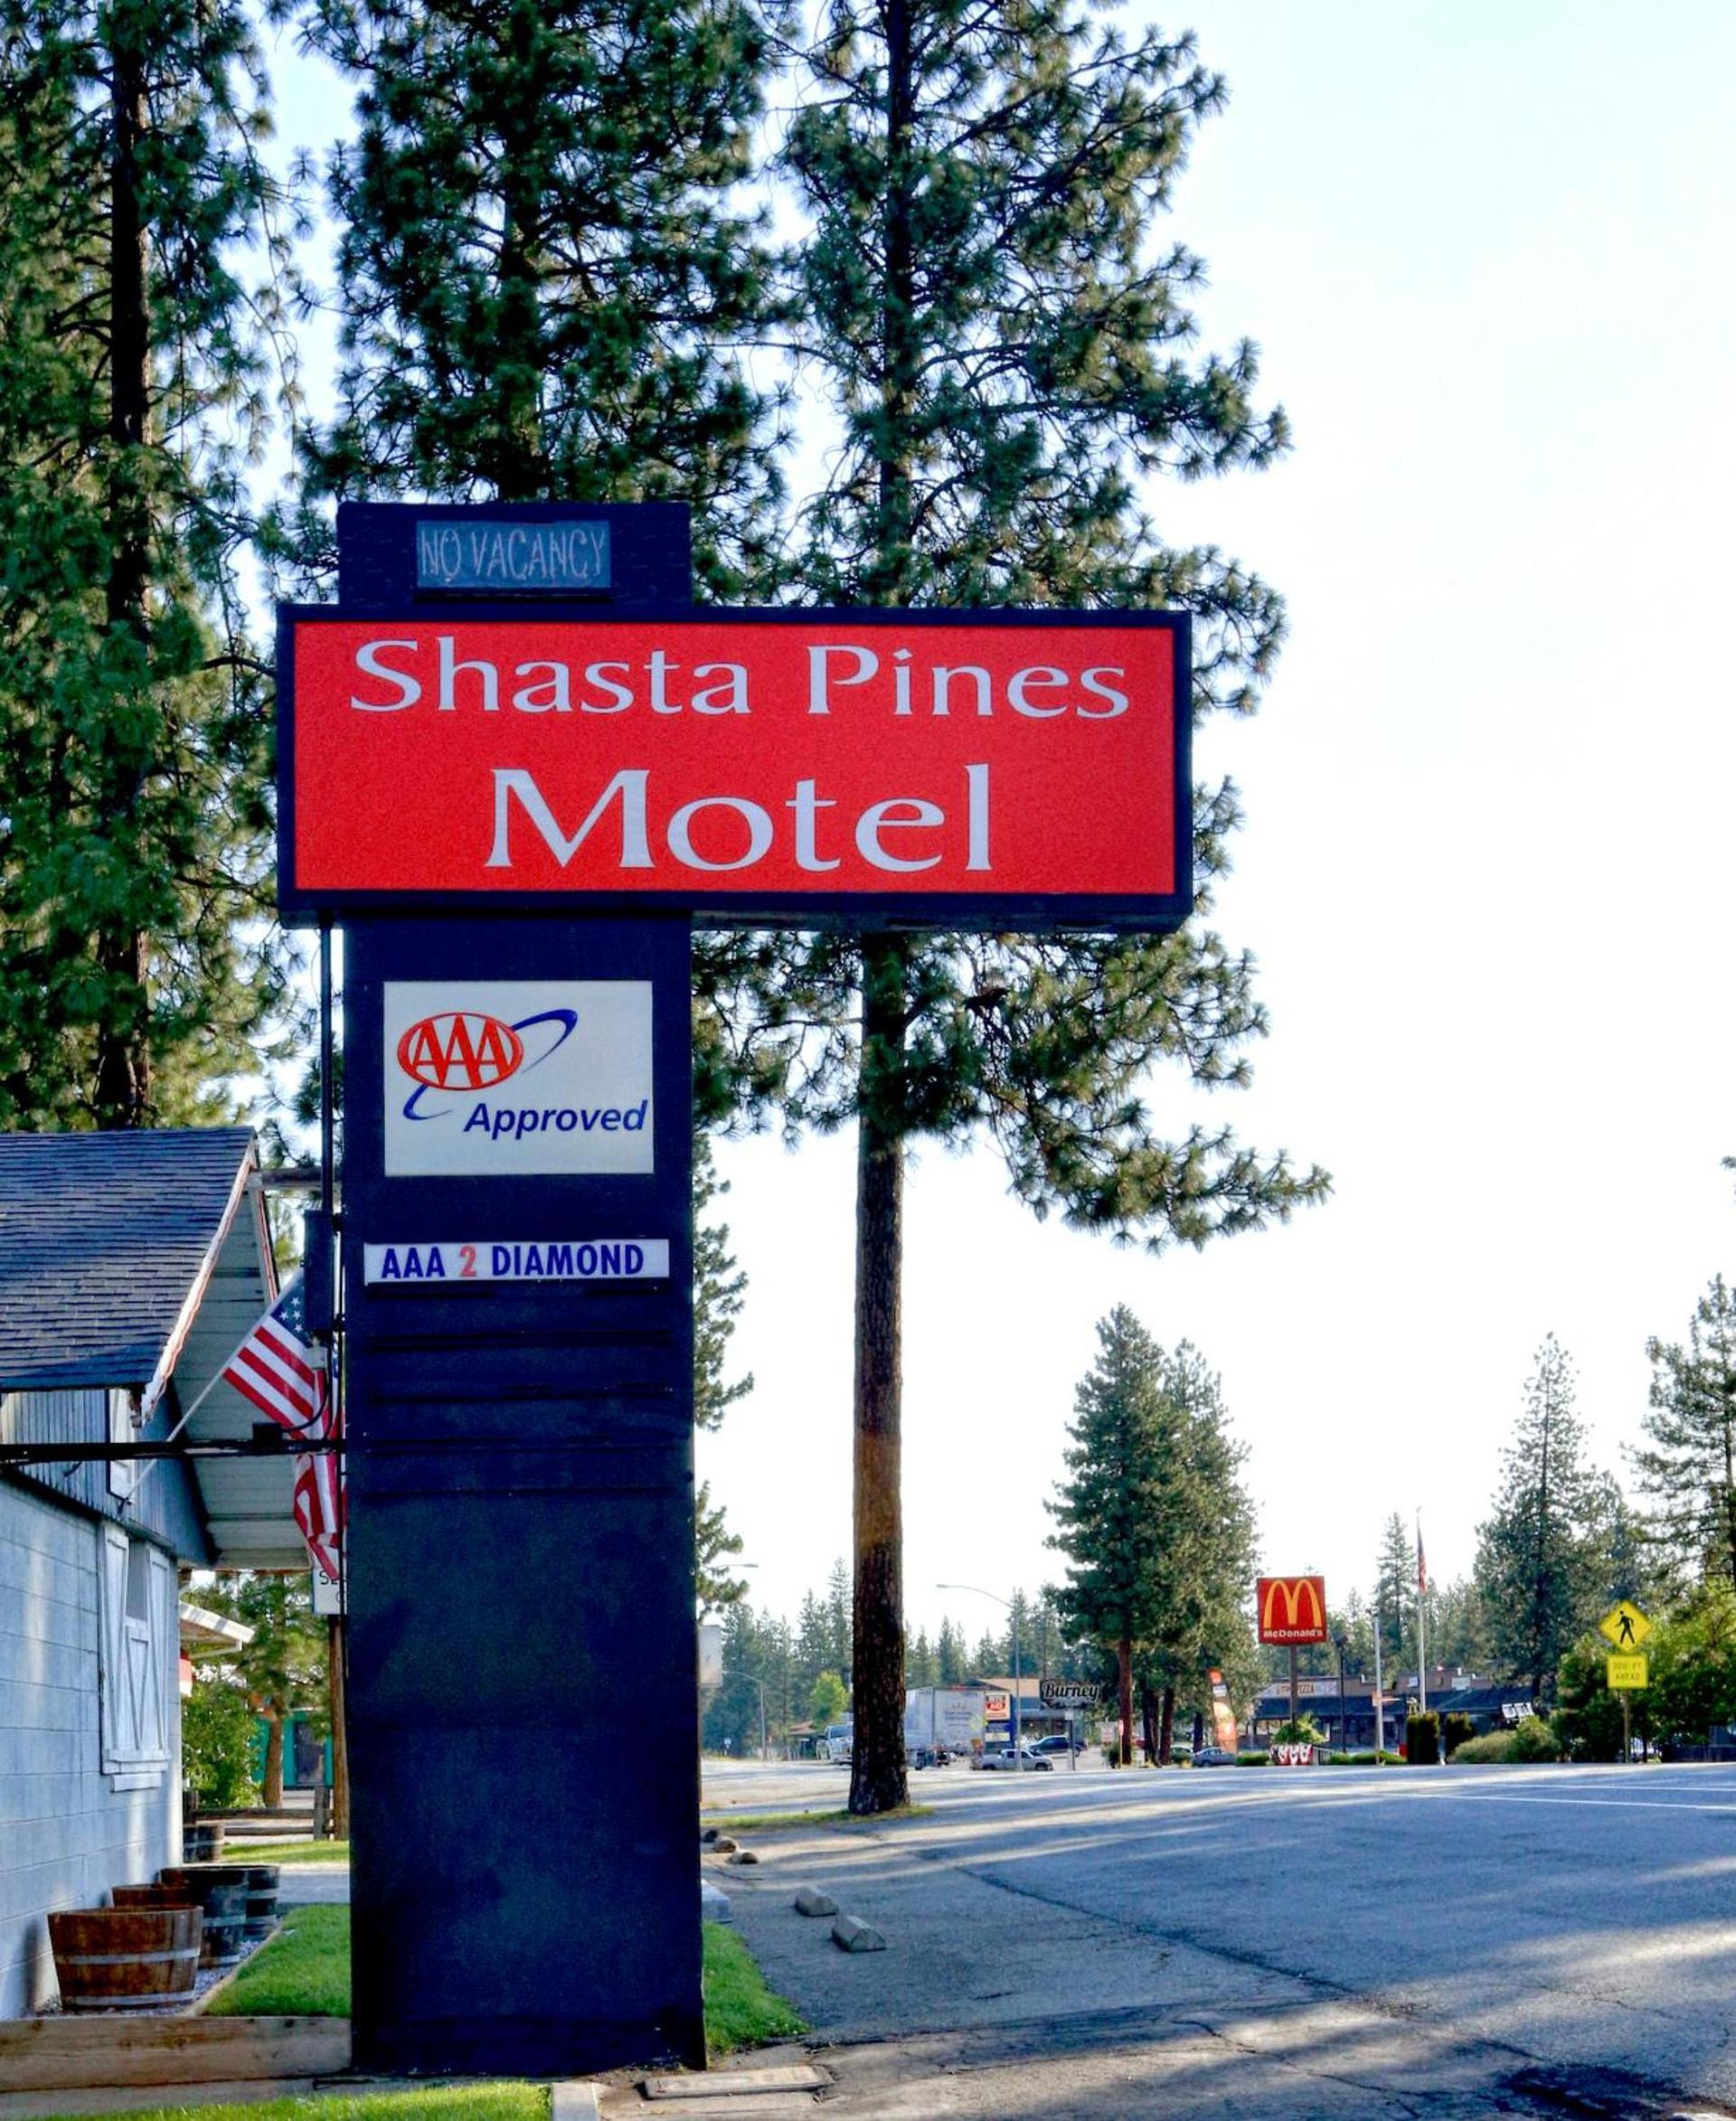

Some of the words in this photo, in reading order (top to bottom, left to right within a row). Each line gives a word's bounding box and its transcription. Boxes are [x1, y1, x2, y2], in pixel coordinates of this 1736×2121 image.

[421, 528, 461, 579] NO
[470, 528, 607, 580] VACANCY
[351, 636, 751, 715] Shasta
[807, 645, 1129, 719] Pines
[485, 762, 993, 873] Motel
[410, 1013, 508, 1089] AAA
[463, 1098, 648, 1140] Approved
[381, 1246, 446, 1279] AAA
[459, 1243, 476, 1277] 2
[491, 1243, 645, 1276] DIAMOND
[1263, 1629, 1324, 1637] McDonald's
[1042, 1682, 1100, 1703] Burney
